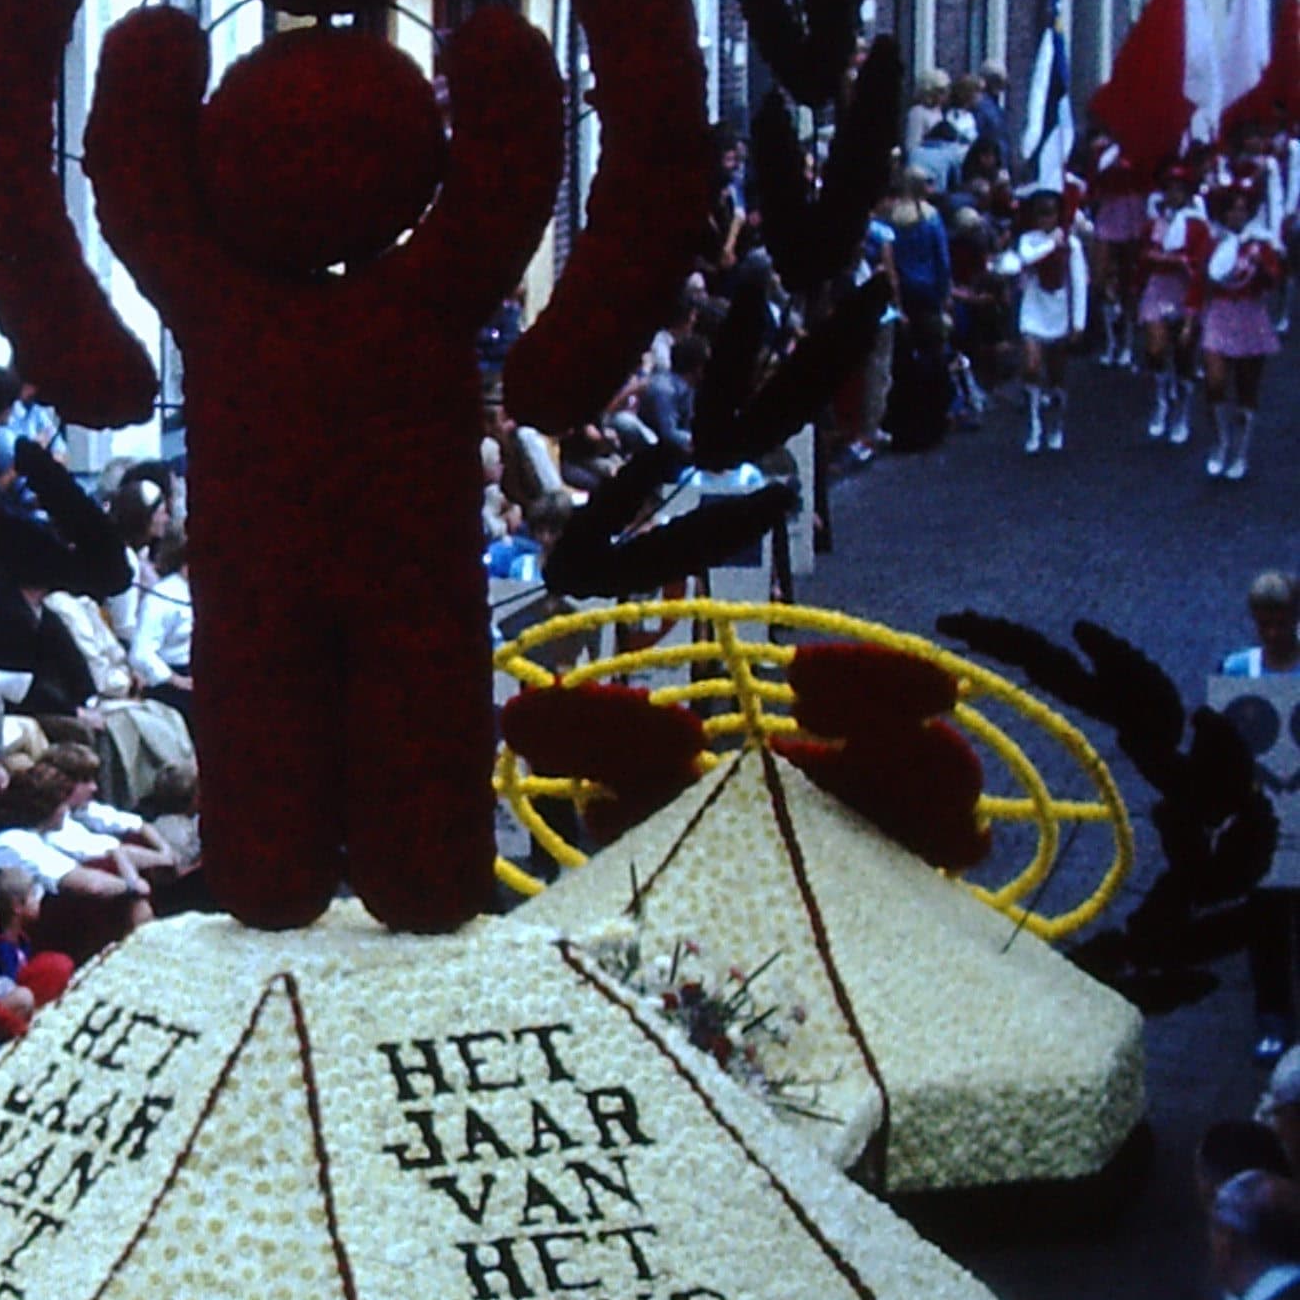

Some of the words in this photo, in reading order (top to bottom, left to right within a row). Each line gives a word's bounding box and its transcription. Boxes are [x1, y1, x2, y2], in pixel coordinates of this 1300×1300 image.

[63, 1002, 200, 1079] HET
[377, 1023, 575, 1100] HET
[5, 1062, 174, 1160] JAAR
[382, 1087, 657, 1170] JAAR
[429, 1156, 643, 1225] VAN
[455, 1225, 658, 1300] HET
